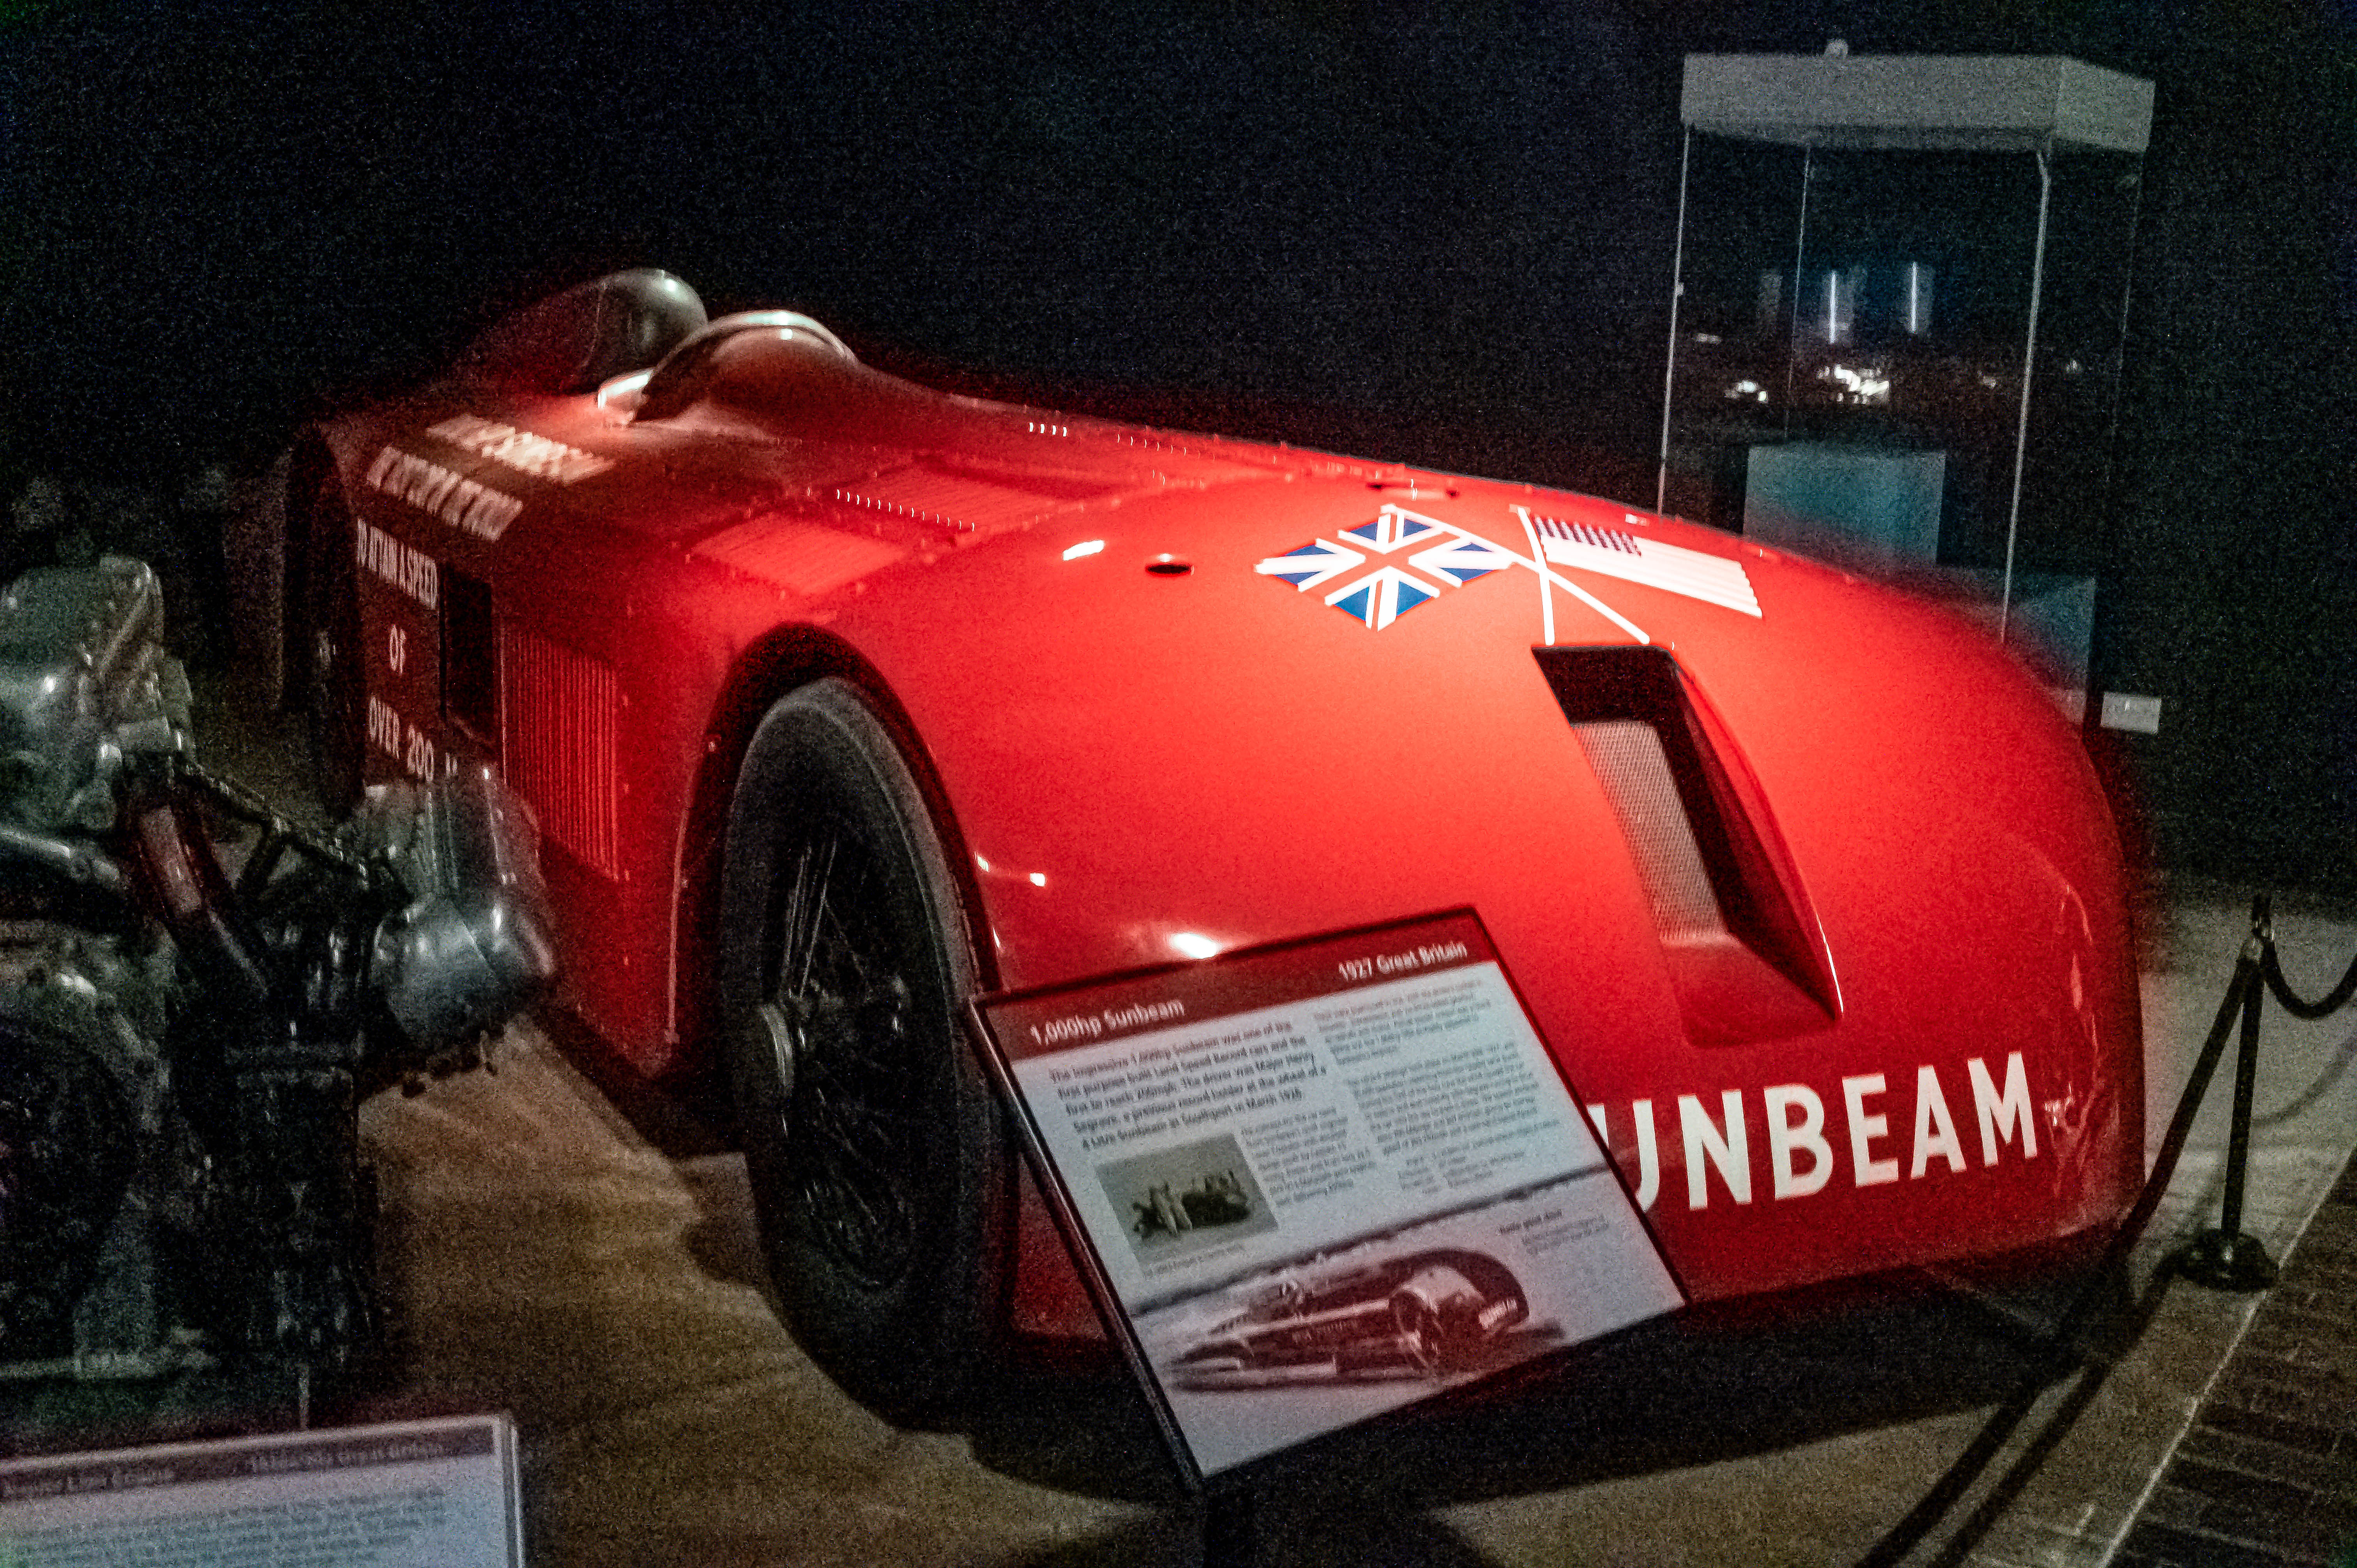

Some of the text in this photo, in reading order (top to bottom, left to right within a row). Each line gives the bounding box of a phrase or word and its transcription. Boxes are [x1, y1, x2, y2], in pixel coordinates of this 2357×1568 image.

[407, 546, 438, 609] SPEED
[390, 624, 406, 676] OF
[369, 696, 400, 759] OVER
[407, 723, 434, 782] 200
[1338, 942, 1467, 980] 1927 Great Britain
[1031, 1000, 1184, 1044] 1,000hp Sunbeam
[1173, 1038, 1219, 1056] Sunbeam
[1221, 1033, 1242, 1045] was
[1243, 1028, 1262, 1041] one
[1262, 1022, 1274, 1036] of
[1065, 1103, 1089, 1116] first
[1089, 1099, 1103, 1111] to
[1105, 1091, 1134, 1108] reach
[1181, 1077, 1201, 1089] The
[1202, 1070, 1232, 1086] driver
[1235, 1065, 1255, 1077] was
[1254, 1058, 1284, 1072] Major
[1285, 1052, 1315, 1066] Henry
[1082, 1077, 1126, 1097] purpose
[1126, 1069, 1152, 1084] built
[1153, 1062, 1180, 1078] Land
[1180, 1054, 1212, 1073] Speed
[1212, 1047, 1248, 1065] Record
[1248, 1044, 1269, 1057] cars
[1270, 1038, 1289, 1052] and
[1289, 1036, 1307, 1048] the
[1117, 1122, 1167, 1142] Sunbeam
[1181, 1105, 1233, 1126] Southport
[1246, 1095, 1277, 1110] March
[1131, 1102, 1176, 1123] previous
[1178, 1091, 1211, 1108] record
[1258, 1077, 1275, 1089] the
[1278, 1069, 1306, 1085] wheel
[1588, 1051, 2038, 1211] UNBEAM
